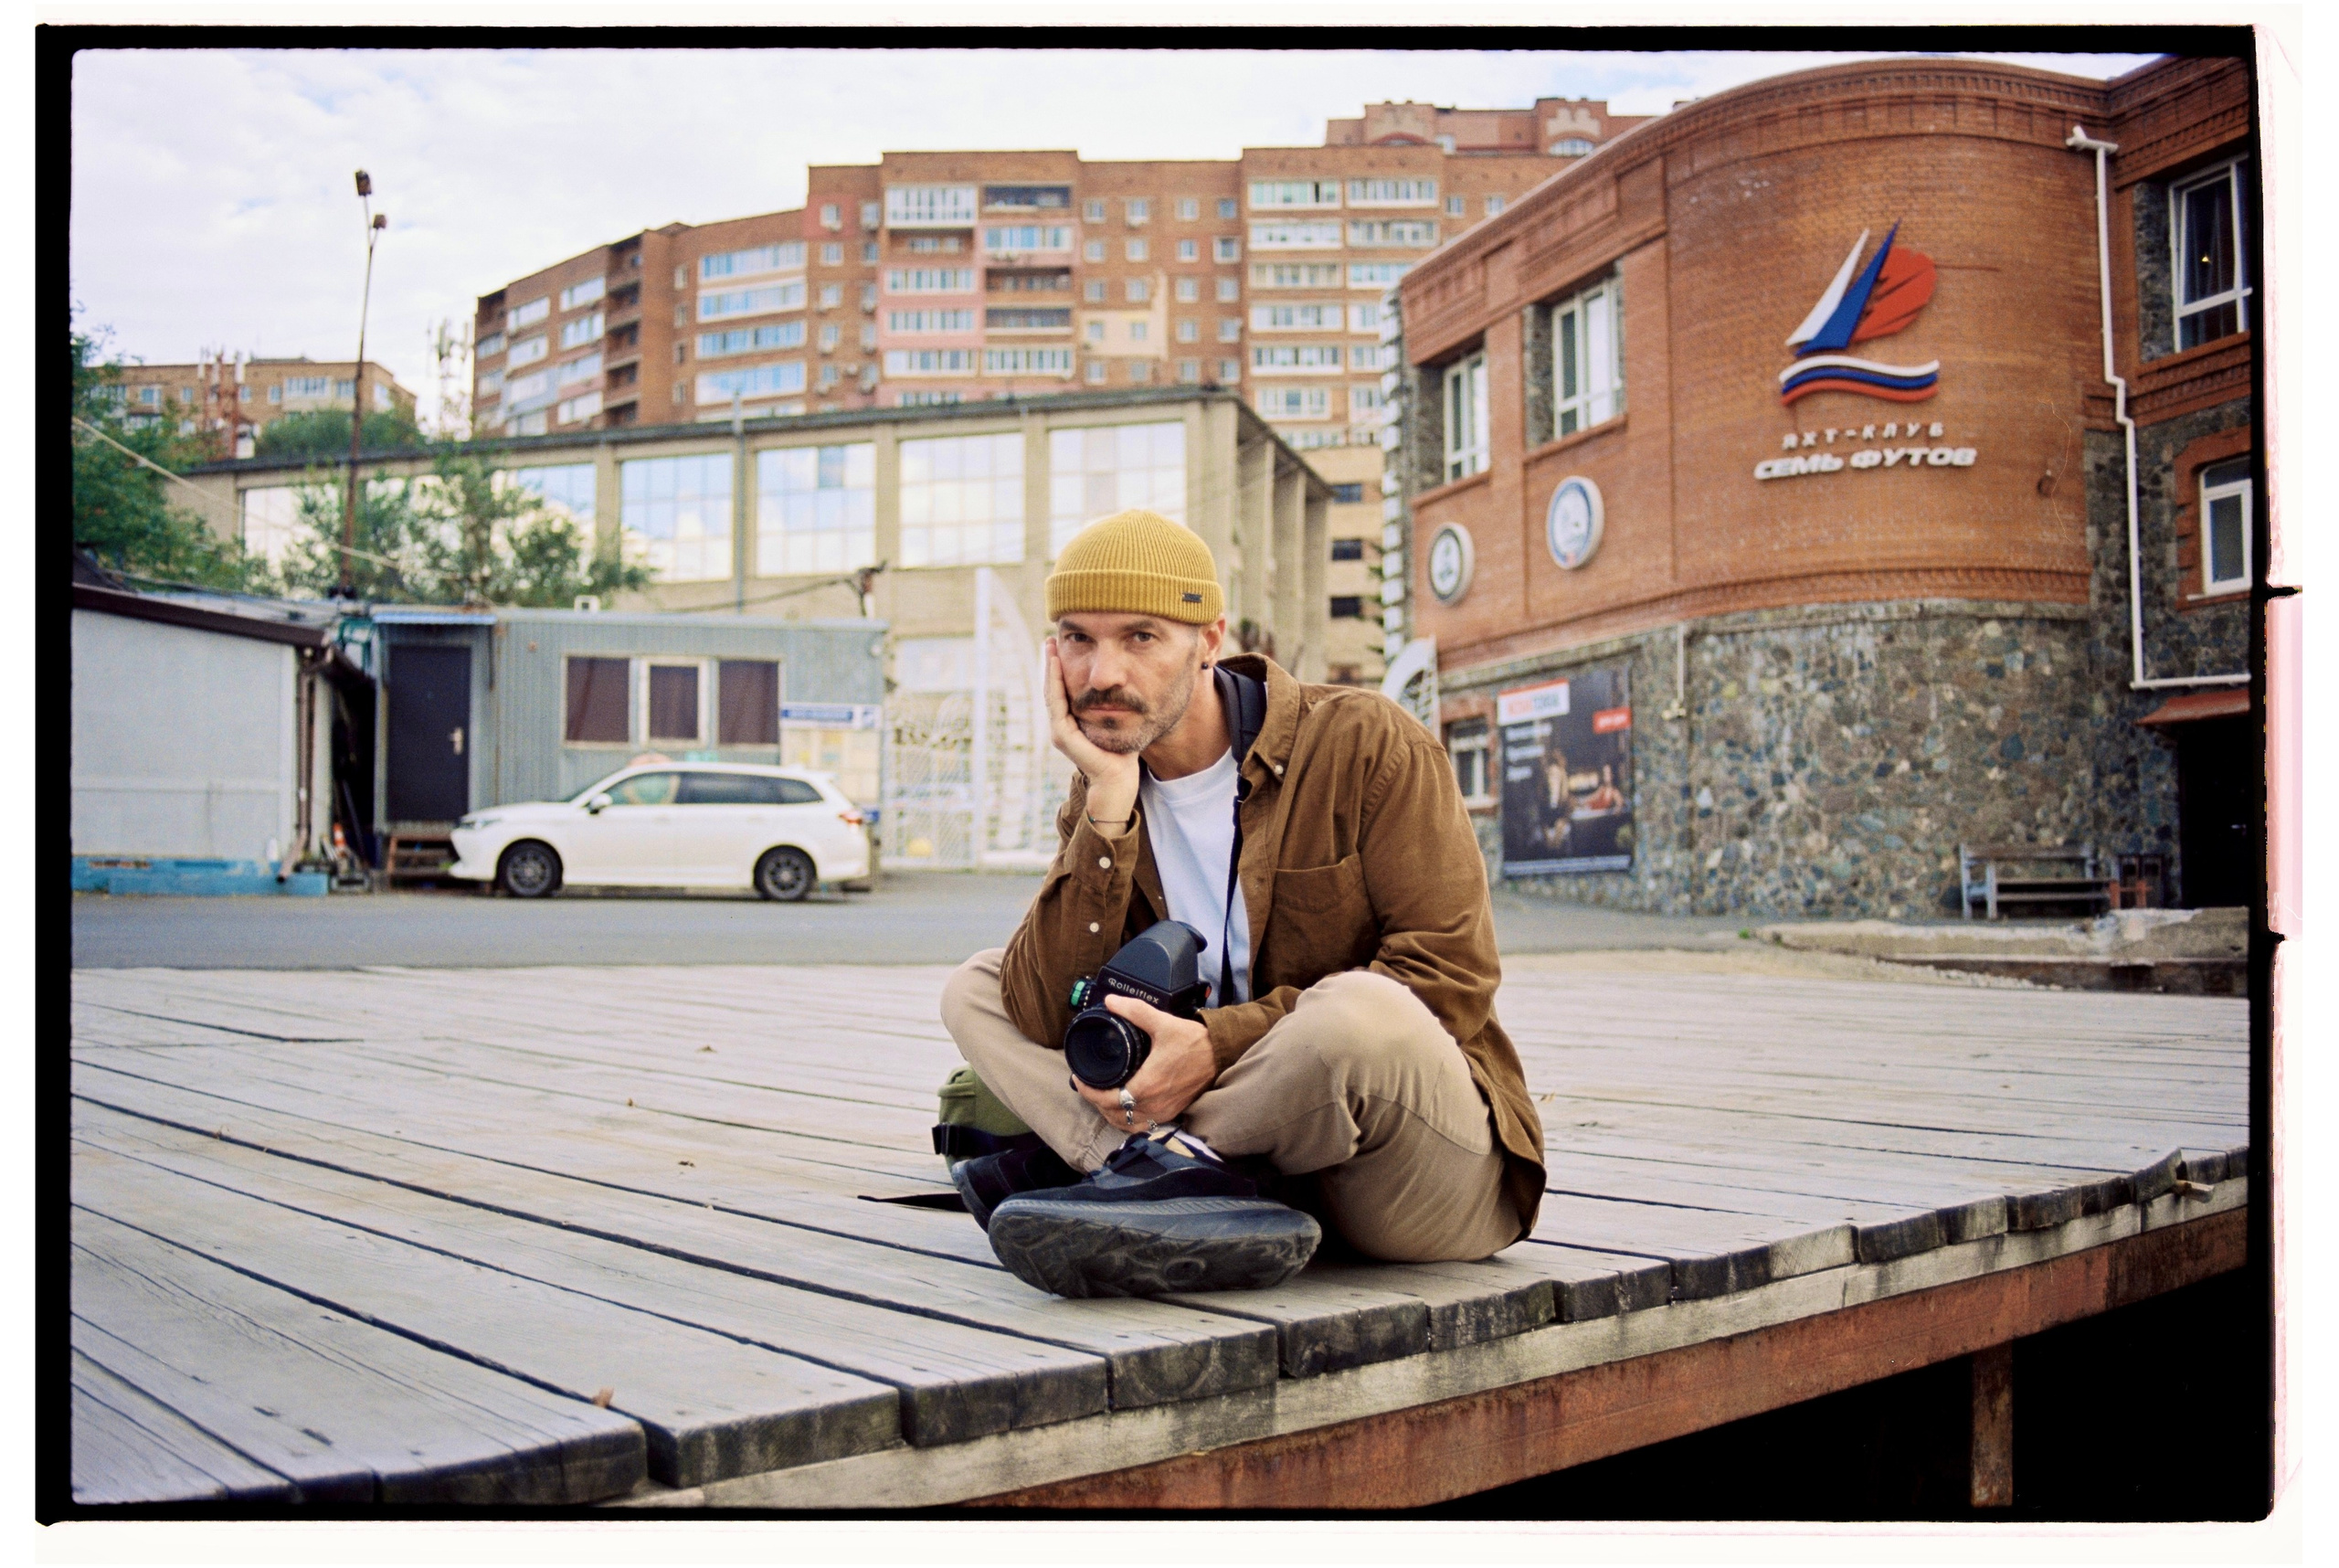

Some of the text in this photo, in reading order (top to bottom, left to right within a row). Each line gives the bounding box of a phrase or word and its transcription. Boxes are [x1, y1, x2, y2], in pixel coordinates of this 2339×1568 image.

[1783, 421, 1943, 450] ЯХТ-КЛУБ
[1754, 448, 1977, 480] СЕМЬ ФУТОВ
[1108, 978, 1159, 1004] Rolleiflex
